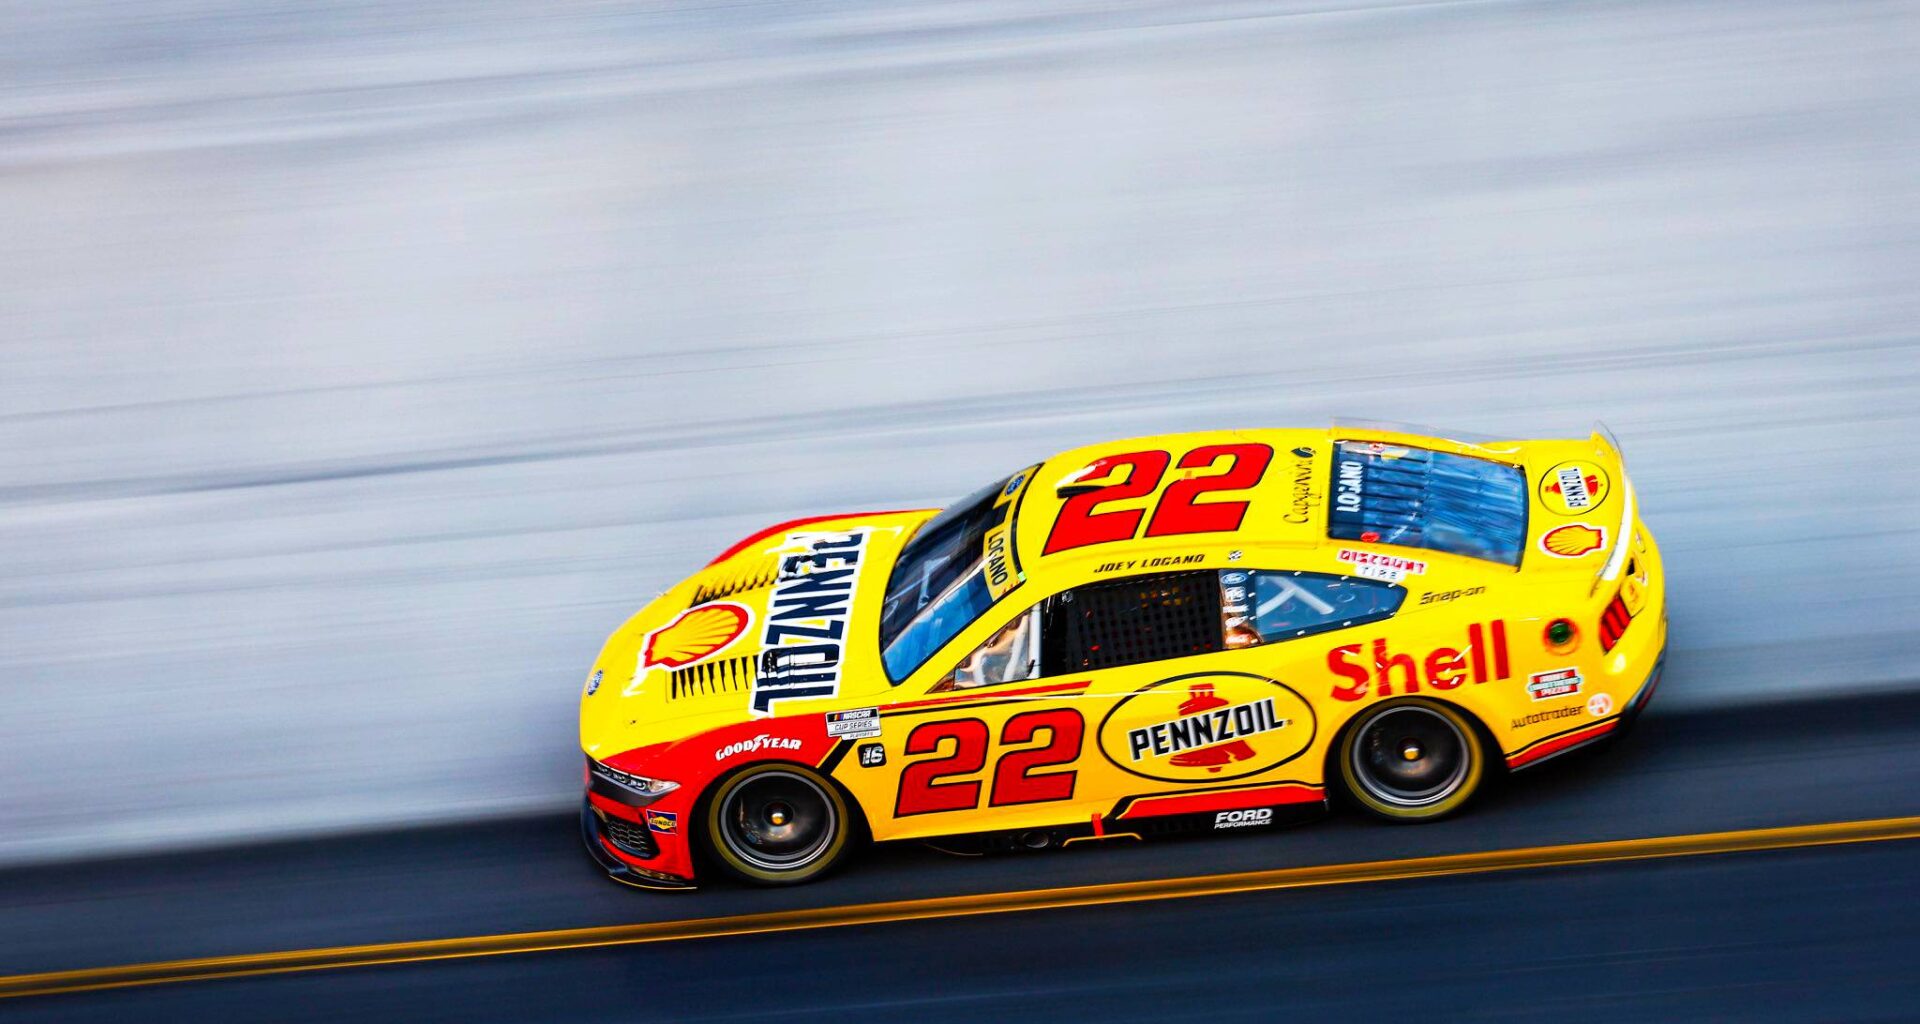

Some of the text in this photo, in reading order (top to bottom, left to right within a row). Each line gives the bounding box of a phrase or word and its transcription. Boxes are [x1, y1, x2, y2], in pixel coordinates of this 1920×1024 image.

[1559, 468, 1589, 508] PENNZOIL
[1042, 443, 1275, 557] 22
[1093, 553, 1205, 573] JOEY LOGANO
[1339, 550, 1425, 573] DISCOUNT
[1361, 566, 1400, 580] TIRE
[1418, 586, 1486, 606] Snap-on
[1327, 619, 1511, 702] Shell
[850, 720, 873, 729] SERIES
[1128, 699, 1285, 761] PENNZOIL
[715, 734, 802, 761] GOODYEAR
[862, 745, 884, 765] 16
[894, 707, 1085, 818] 22
[649, 815, 676, 828] SUNOCO
[1214, 818, 1273, 829] PERFORMANCE
[1215, 808, 1273, 823] FORD
